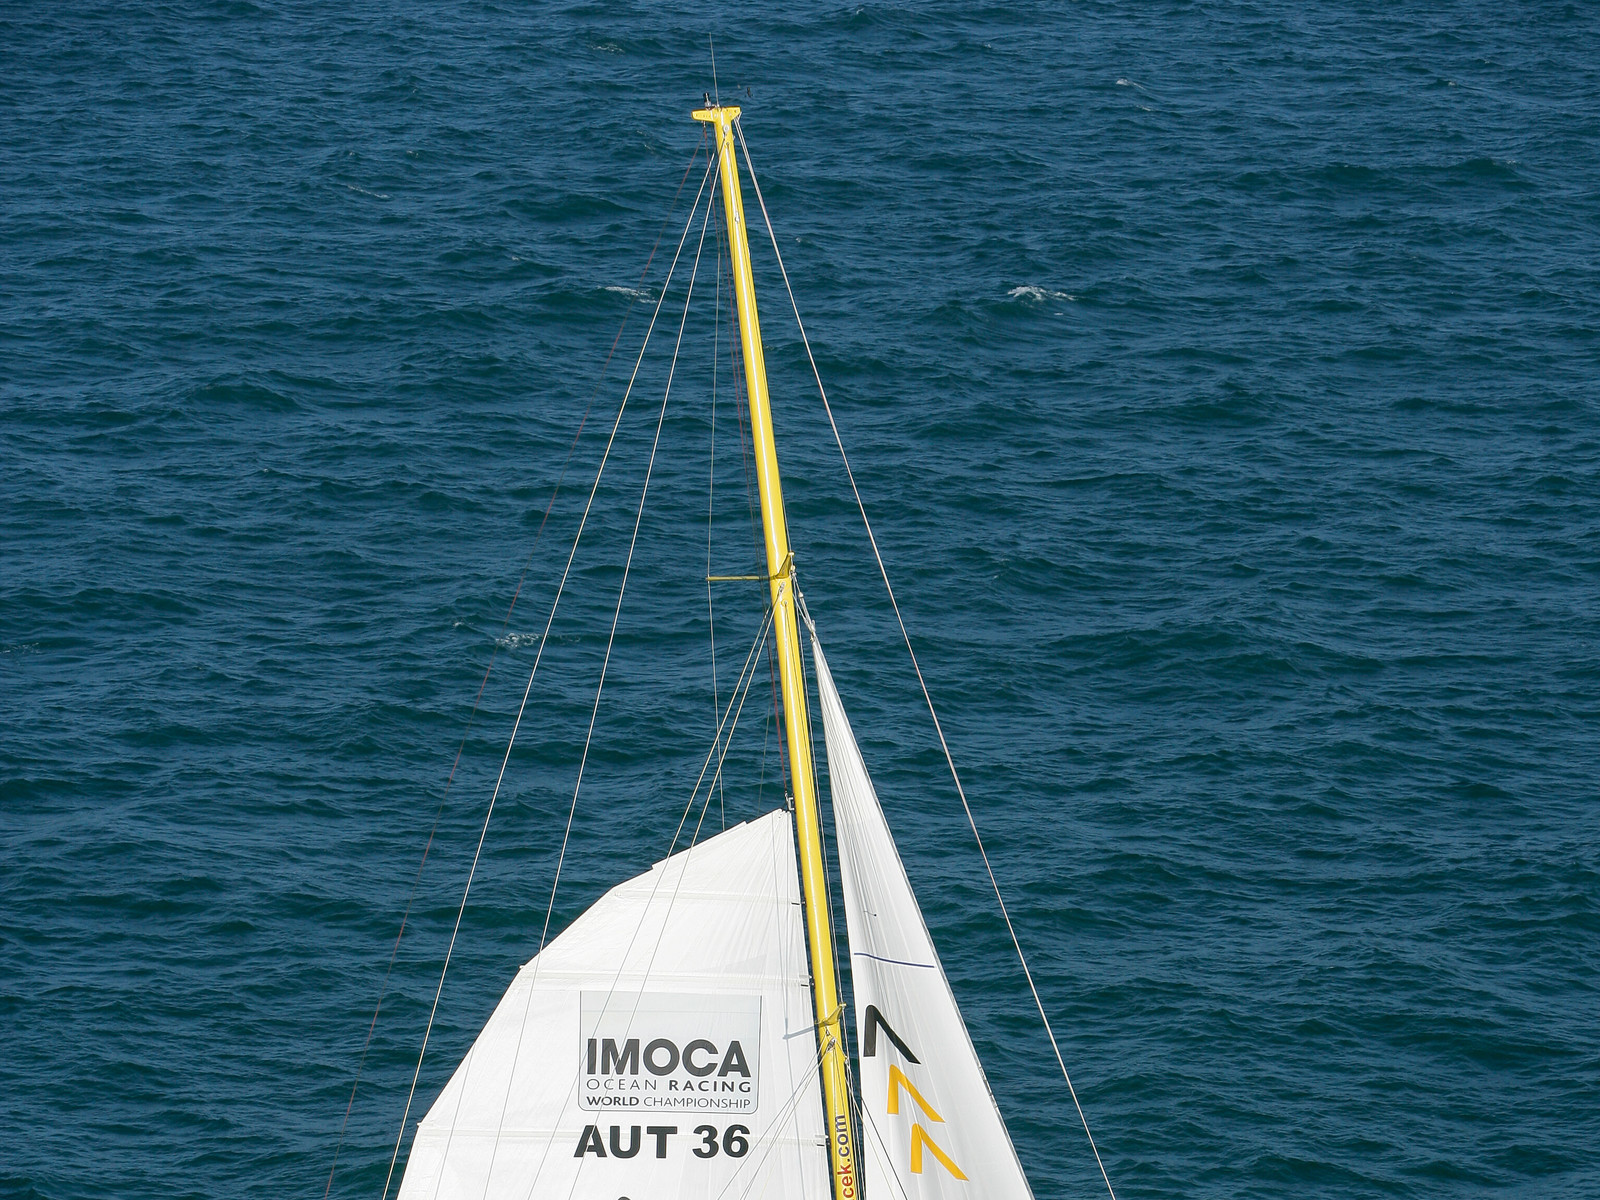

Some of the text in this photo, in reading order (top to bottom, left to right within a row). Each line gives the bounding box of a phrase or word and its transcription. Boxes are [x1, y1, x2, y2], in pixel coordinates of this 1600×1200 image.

[586, 1038, 752, 1078] IMOCA
[586, 1078, 751, 1093] OCEAN RACING
[586, 1096, 751, 1109] WORLD CHAMPIONSHIP
[574, 1124, 751, 1158] AUT 36
